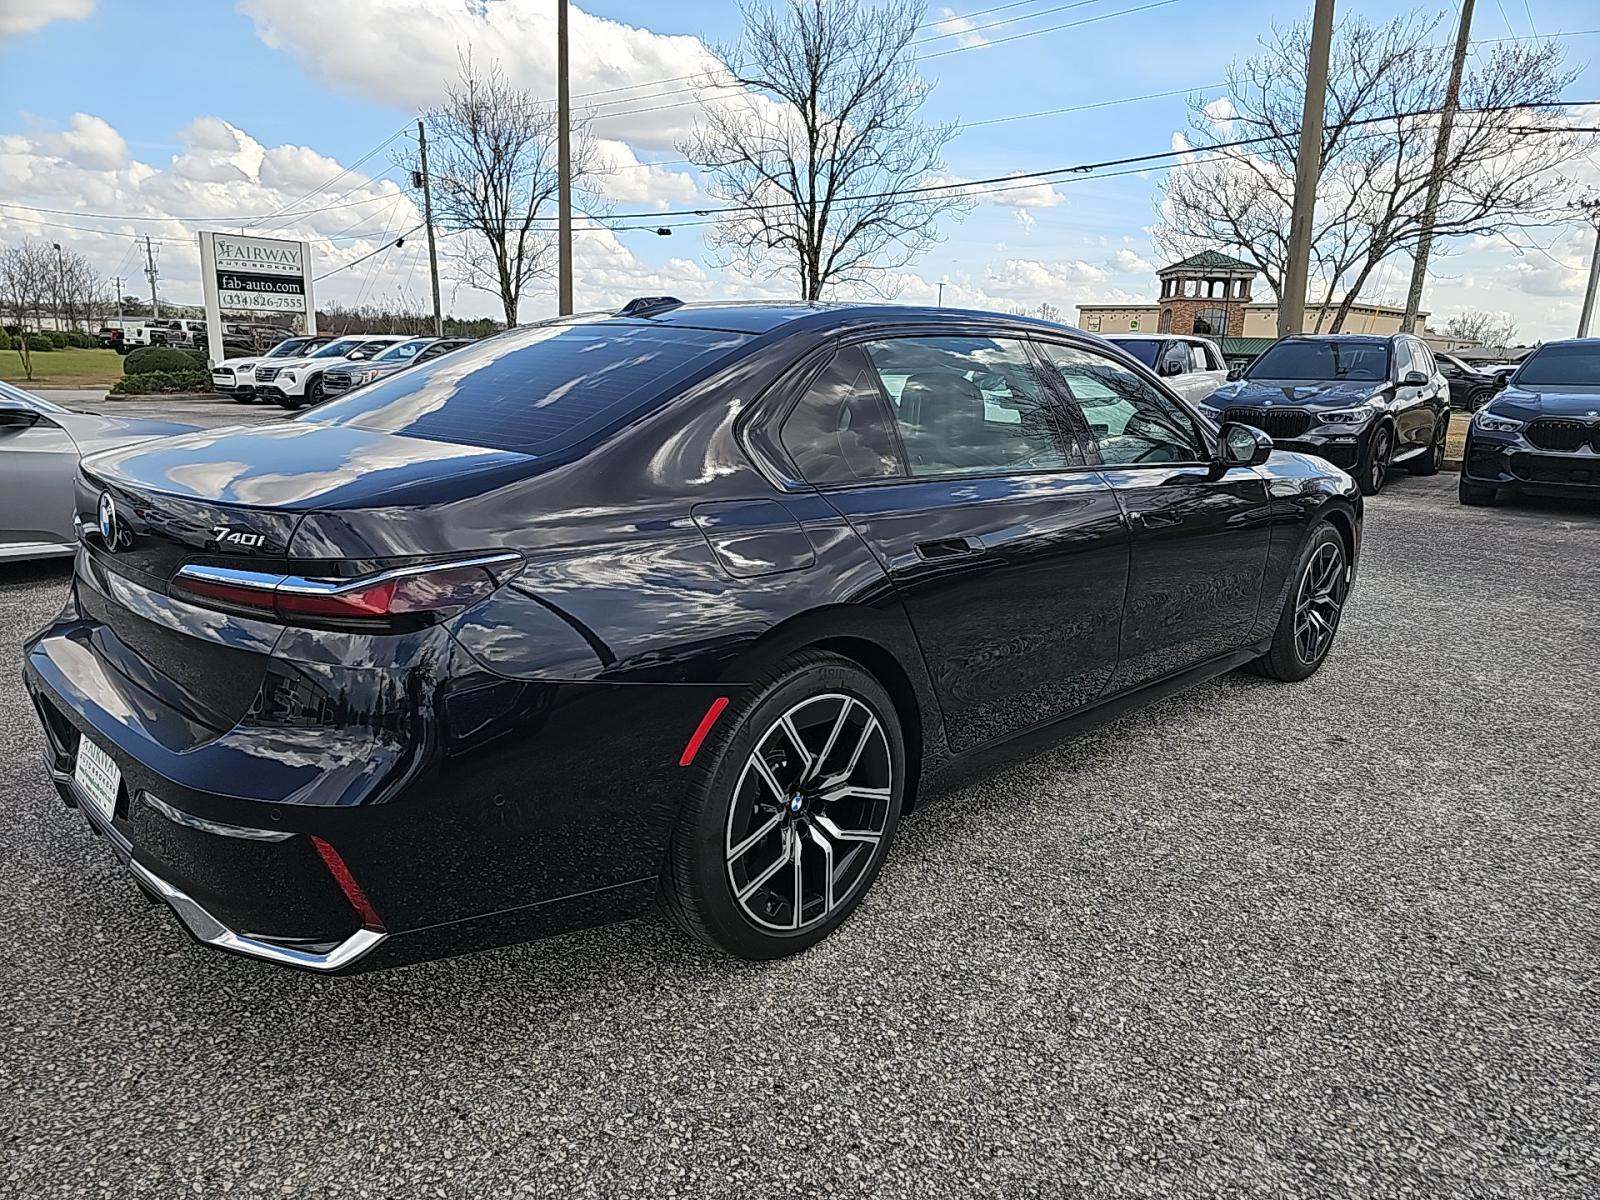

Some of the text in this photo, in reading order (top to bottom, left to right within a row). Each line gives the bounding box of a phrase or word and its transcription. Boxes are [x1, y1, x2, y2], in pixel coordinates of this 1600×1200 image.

[226, 244, 298, 263] FAIRWAY
[252, 262, 301, 271] BROKERS
[222, 275, 300, 293] fab-auto.com
[223, 293, 302, 308] (334)826-7555
[213, 526, 265, 547] 740i
